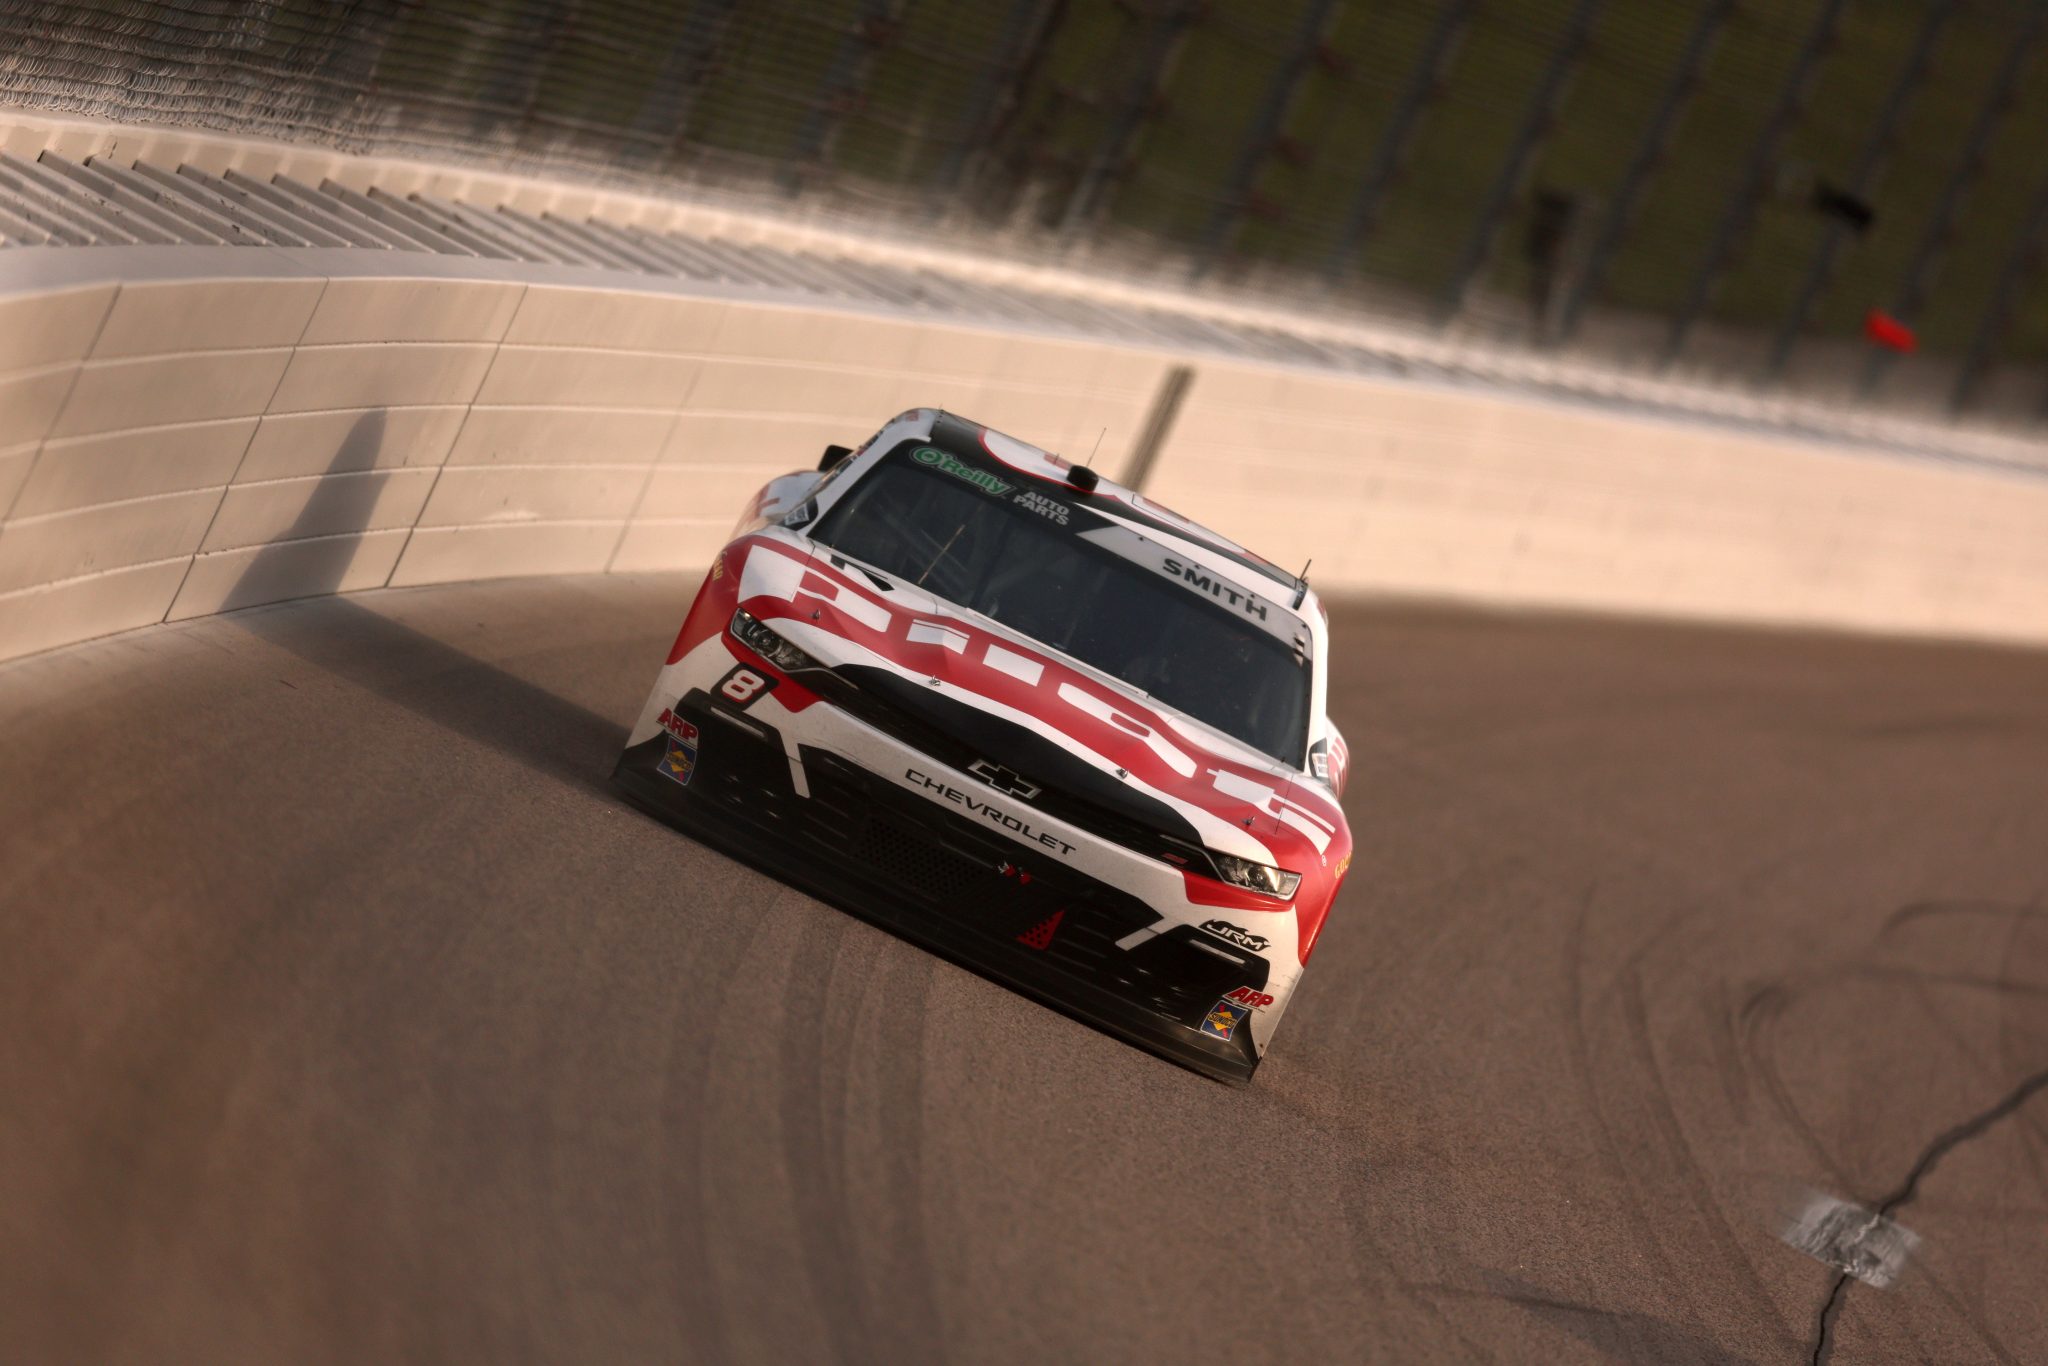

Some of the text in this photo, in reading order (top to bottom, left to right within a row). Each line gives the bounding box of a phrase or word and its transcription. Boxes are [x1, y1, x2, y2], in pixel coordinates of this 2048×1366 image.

[913, 447, 1012, 495] O'Reilly
[1013, 495, 1070, 526] PARTS
[1023, 491, 1070, 515] AUTO
[1162, 558, 1268, 622] SMITH
[721, 669, 765, 703] 8
[657, 708, 698, 741] ARP
[905, 768, 1077, 855] CHEVROLET
[1205, 923, 1264, 950] JRM
[1228, 986, 1275, 1008] ARP
